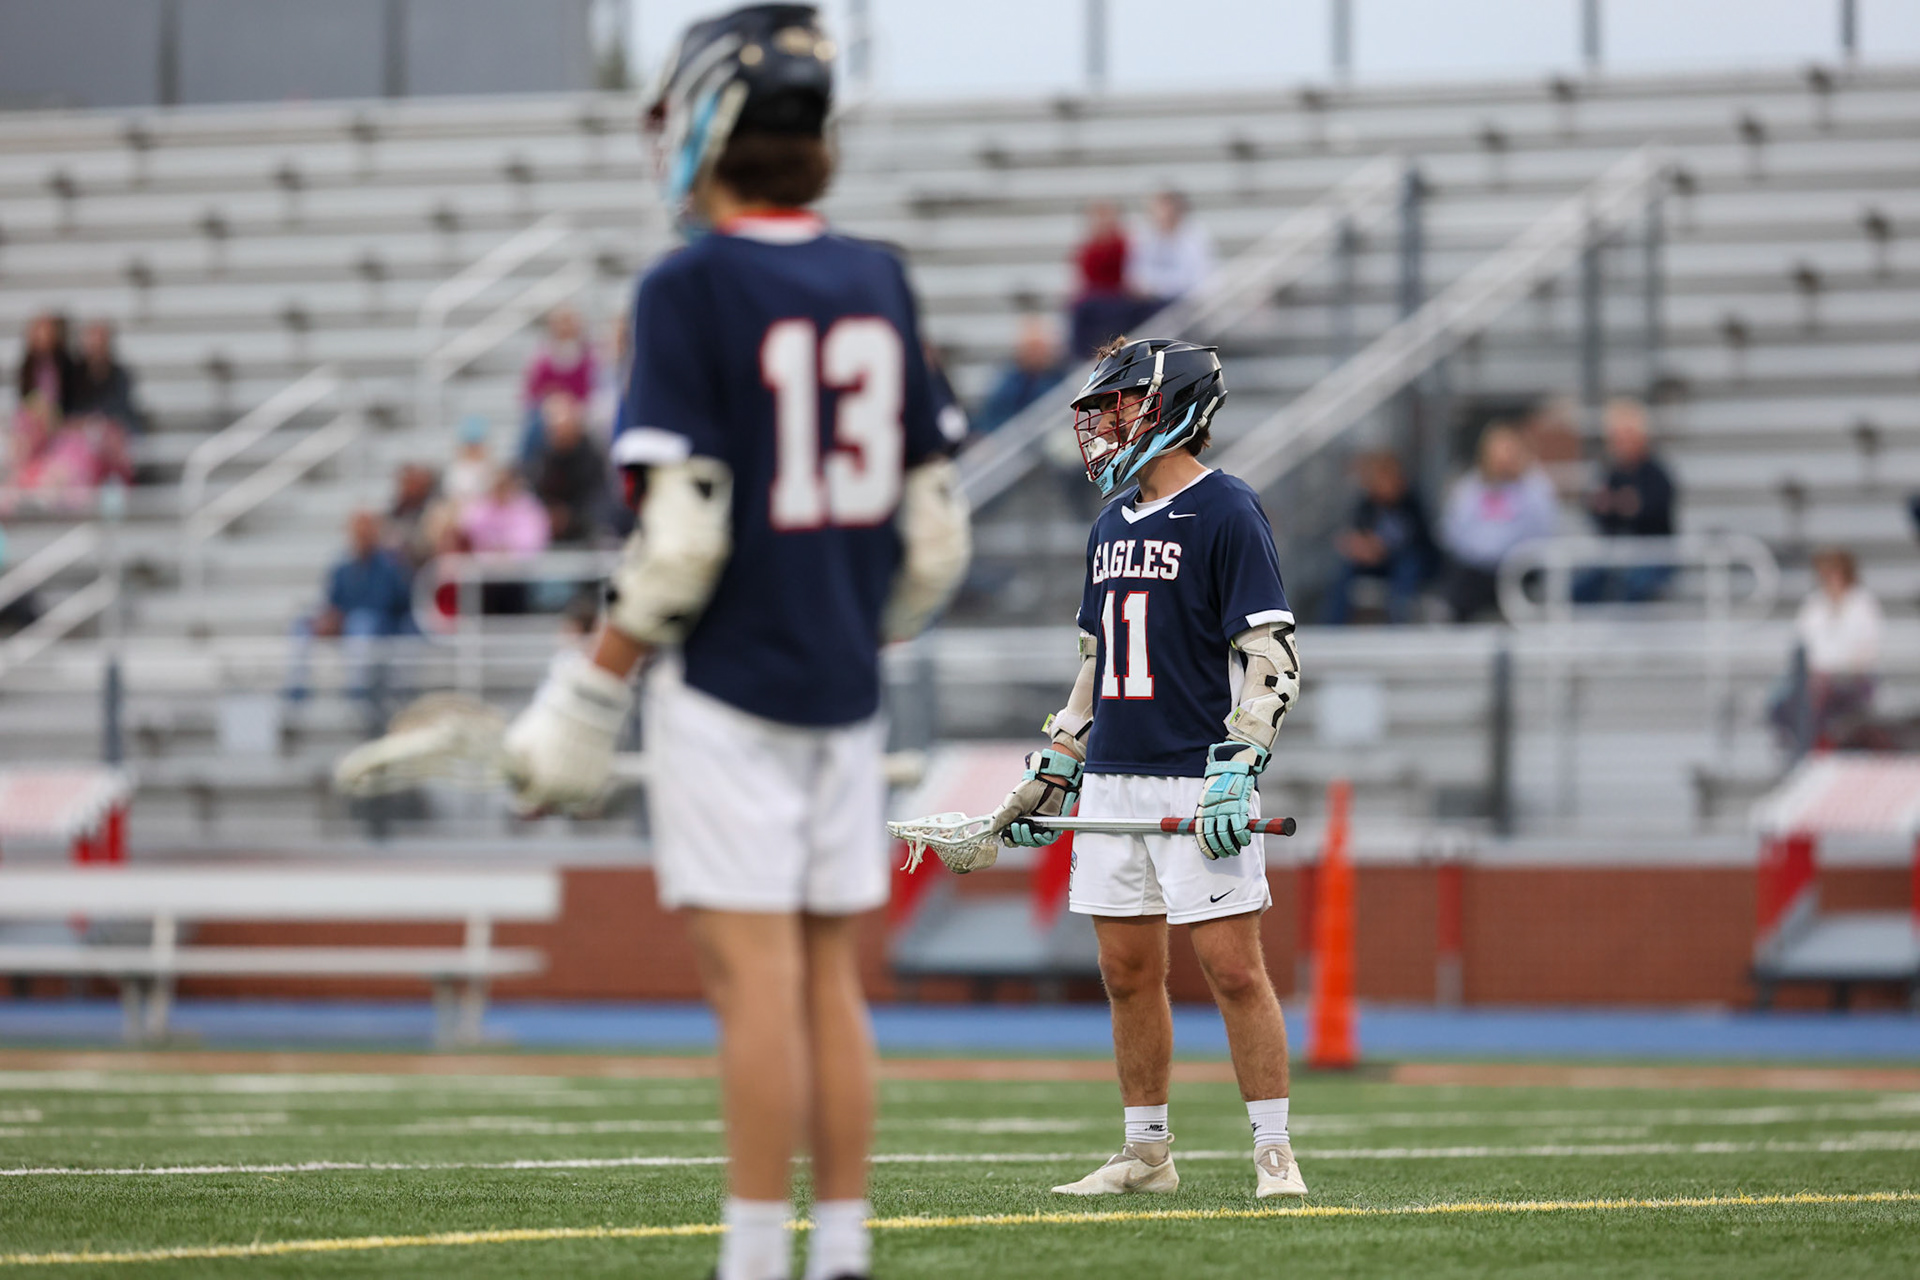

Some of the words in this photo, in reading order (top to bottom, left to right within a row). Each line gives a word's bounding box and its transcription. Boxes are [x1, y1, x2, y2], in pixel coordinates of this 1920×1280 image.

[761, 315, 904, 531] 13
[1093, 539, 1182, 585] EAGLES
[1101, 590, 1155, 700] 11
